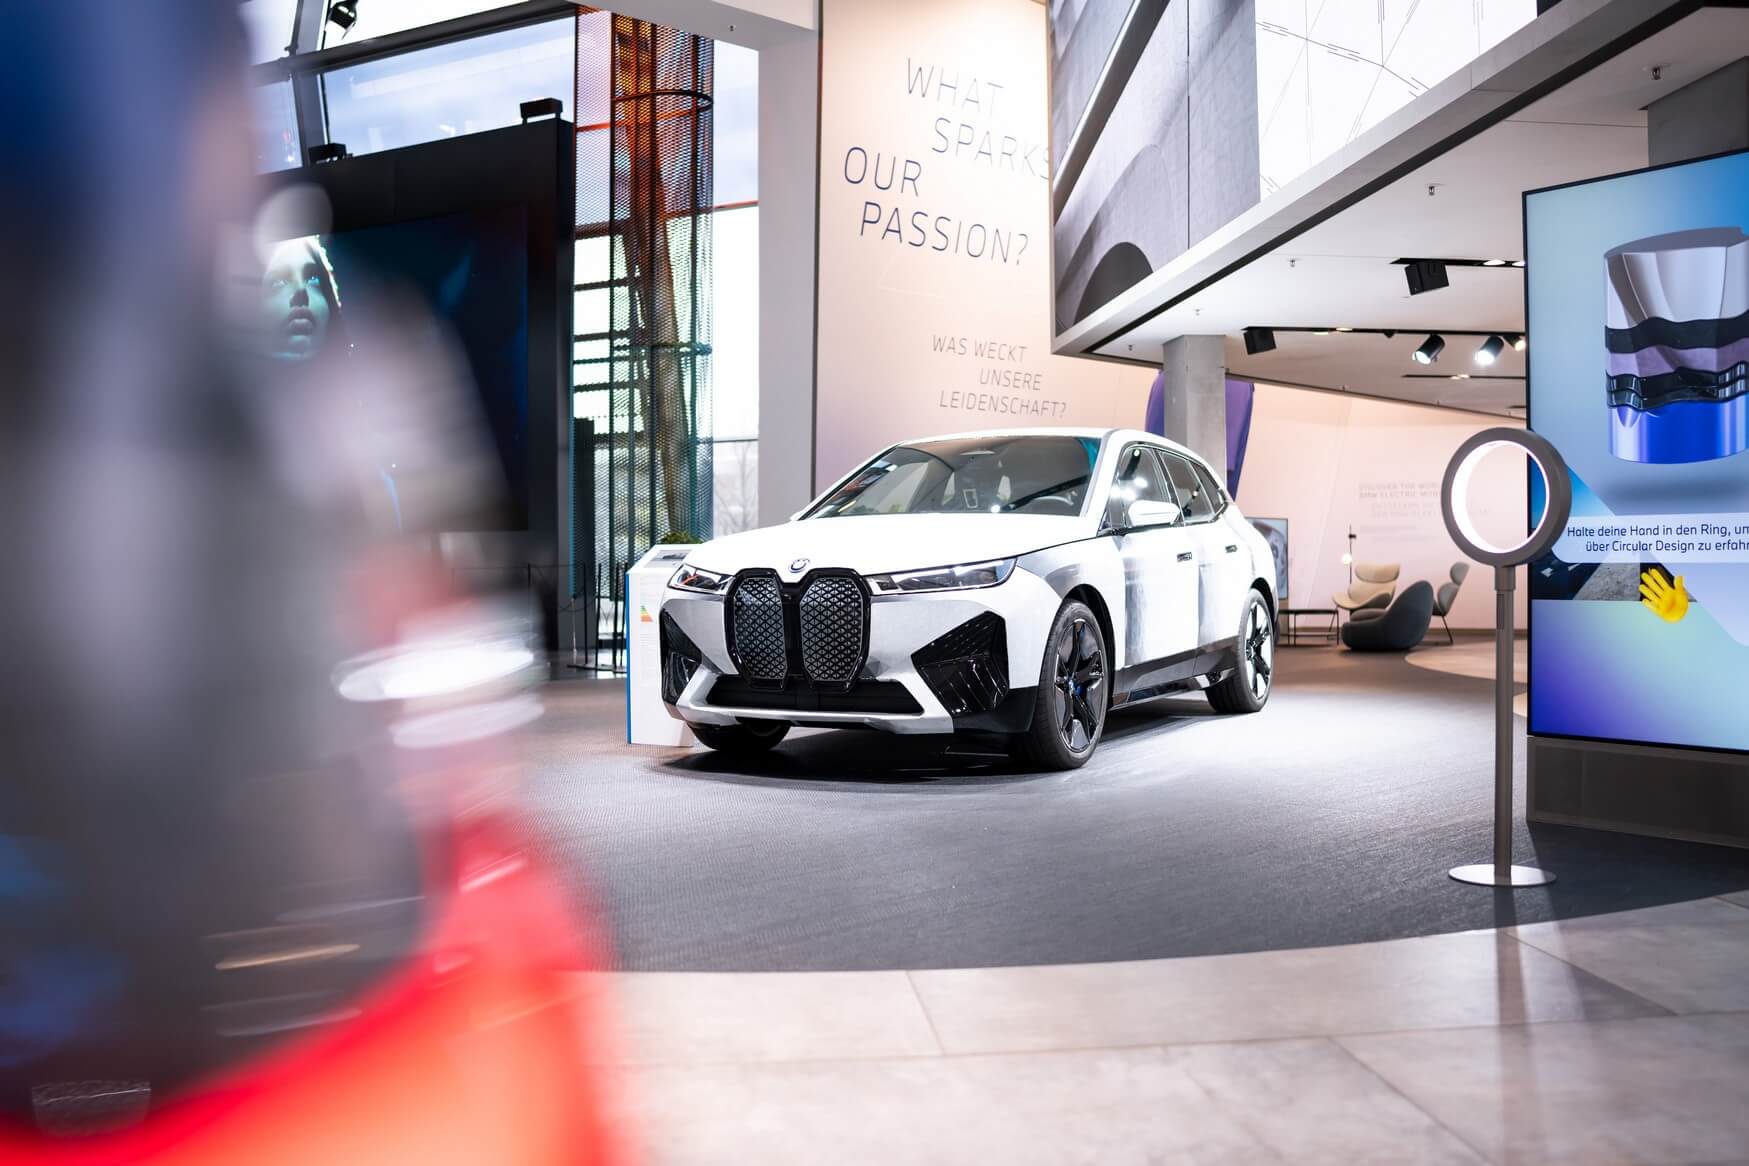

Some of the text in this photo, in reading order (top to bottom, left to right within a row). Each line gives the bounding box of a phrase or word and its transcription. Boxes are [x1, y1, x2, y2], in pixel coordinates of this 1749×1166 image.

[907, 57, 1005, 117] WHAT
[844, 146, 922, 198] OUR
[860, 200, 1029, 266] PASSION?
[932, 334, 1028, 363] WAS WECKT
[979, 367, 1042, 391] UNSERE
[939, 390, 1067, 419] LEIDENSCHAFT?
[1567, 526, 1595, 537] Halte
[1598, 526, 1627, 536] deine
[1630, 525, 1659, 536] Hand
[1663, 525, 1672, 535] in
[1676, 524, 1697, 535] den
[1701, 523, 1731, 537] Ring,
[1586, 541, 1609, 551] über
[1612, 540, 1652, 551] Circular
[1656, 540, 1694, 553] Design
[1698, 542, 1711, 551] zu
